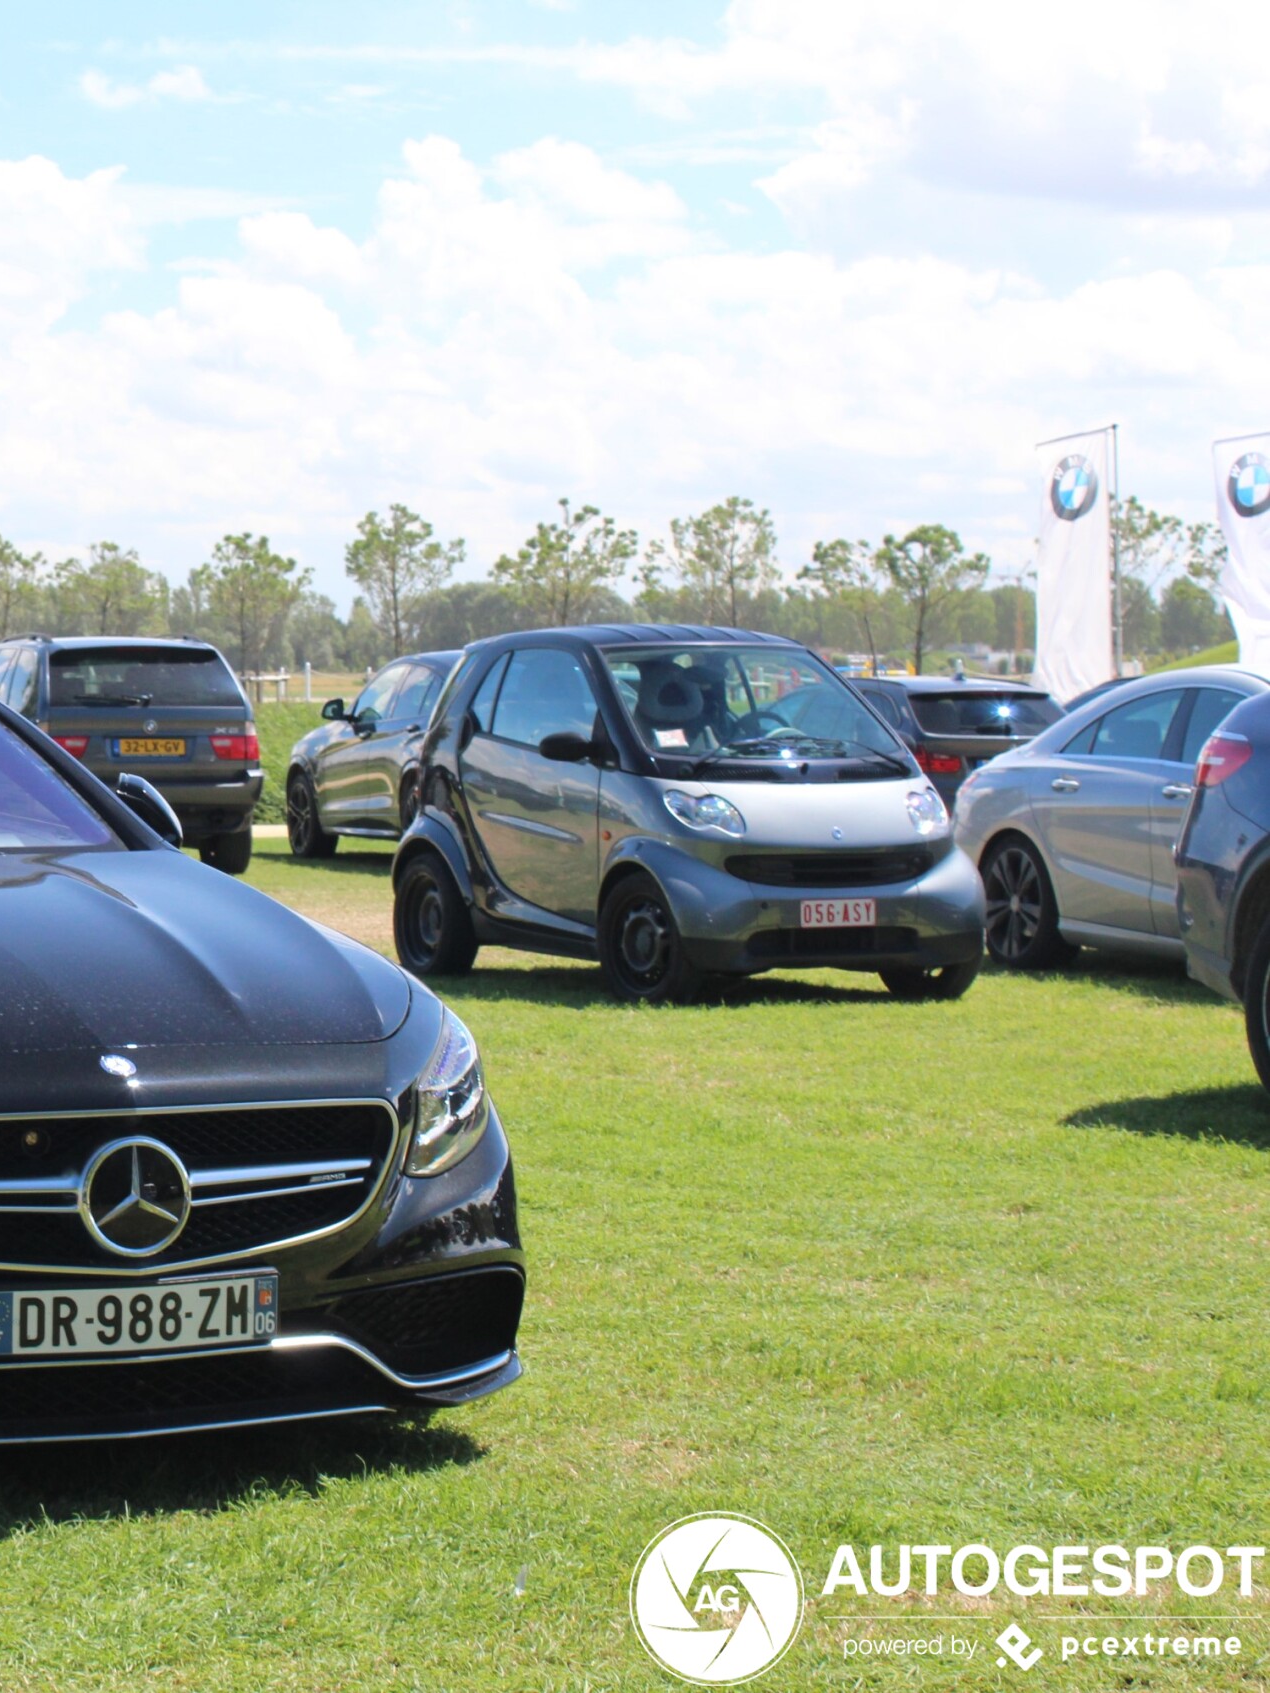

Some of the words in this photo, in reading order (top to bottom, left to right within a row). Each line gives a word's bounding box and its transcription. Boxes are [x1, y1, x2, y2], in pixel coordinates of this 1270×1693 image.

[124, 741, 181, 753] 32-LX-GV
[18, 1284, 250, 1349] DR-988-ZM
[254, 1311, 276, 1335] 06
